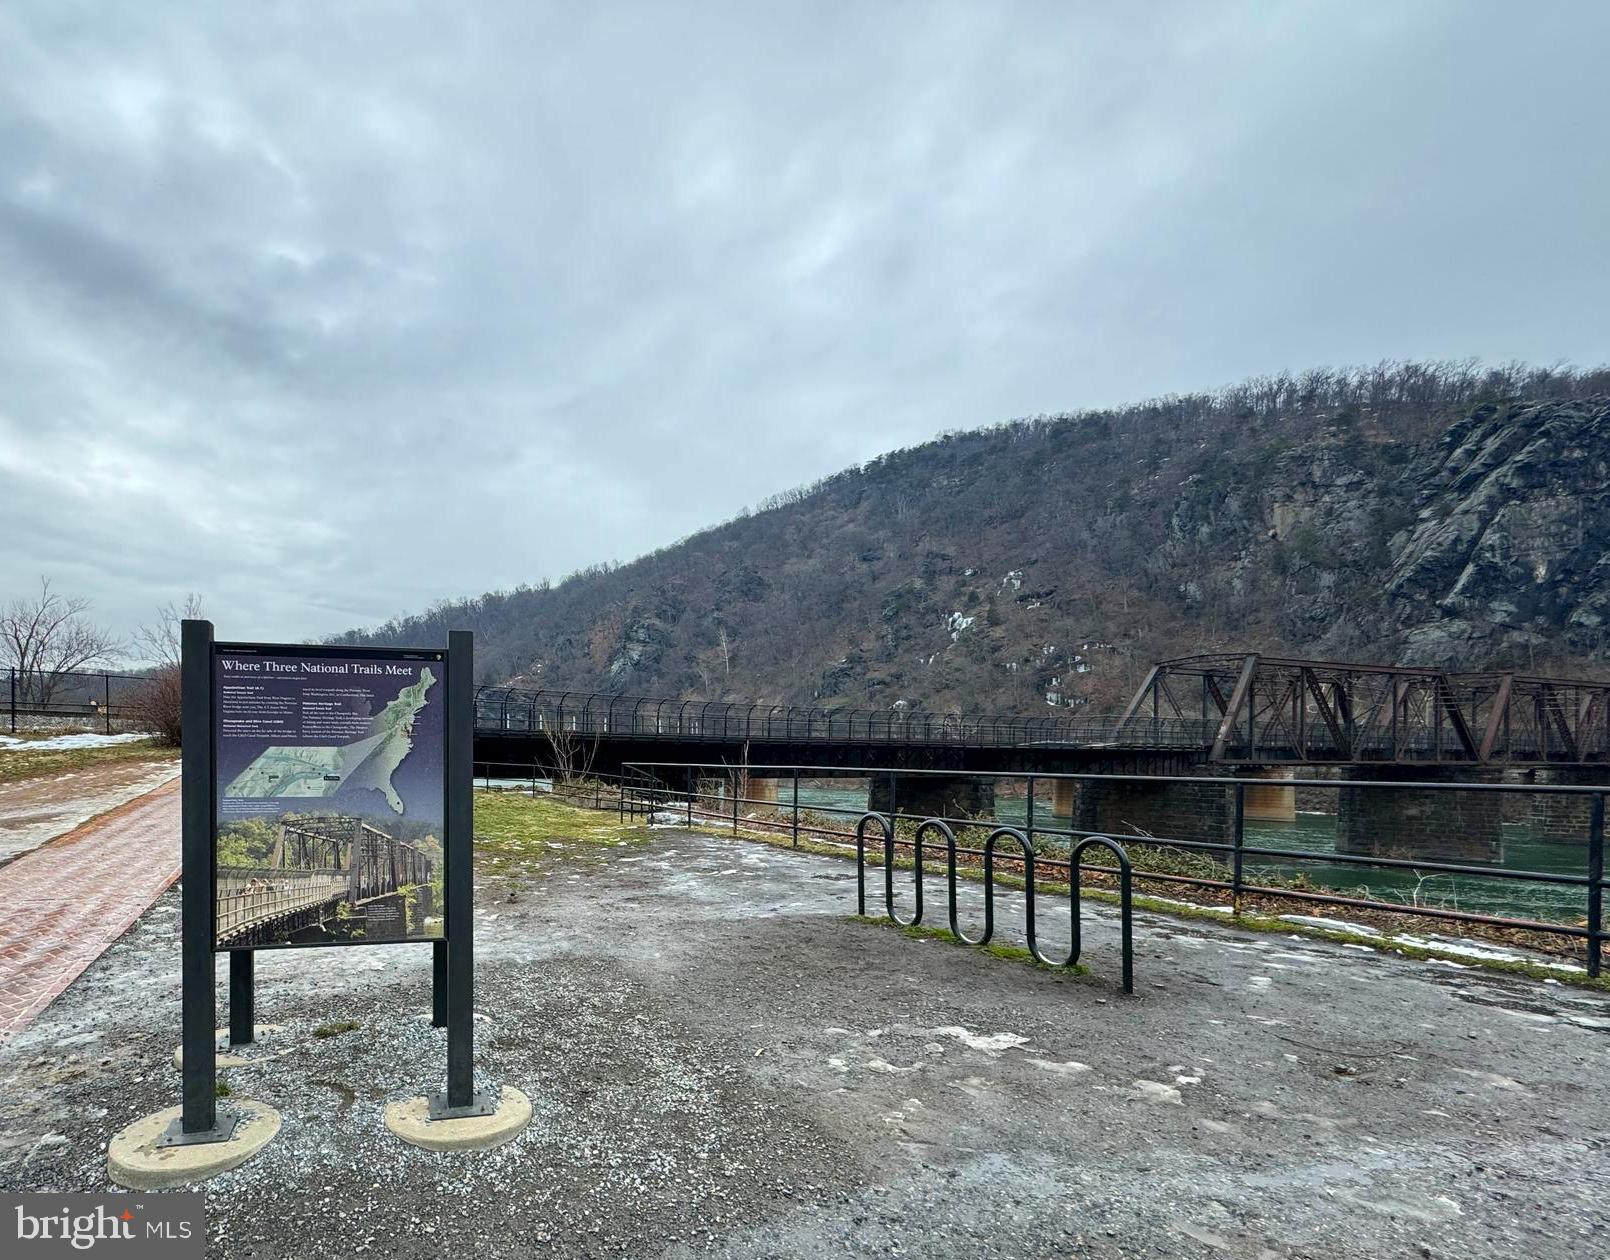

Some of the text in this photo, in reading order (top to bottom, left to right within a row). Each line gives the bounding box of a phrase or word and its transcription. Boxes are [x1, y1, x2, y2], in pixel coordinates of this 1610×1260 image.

[221, 660, 413, 676] Where Three National Trails Meet
